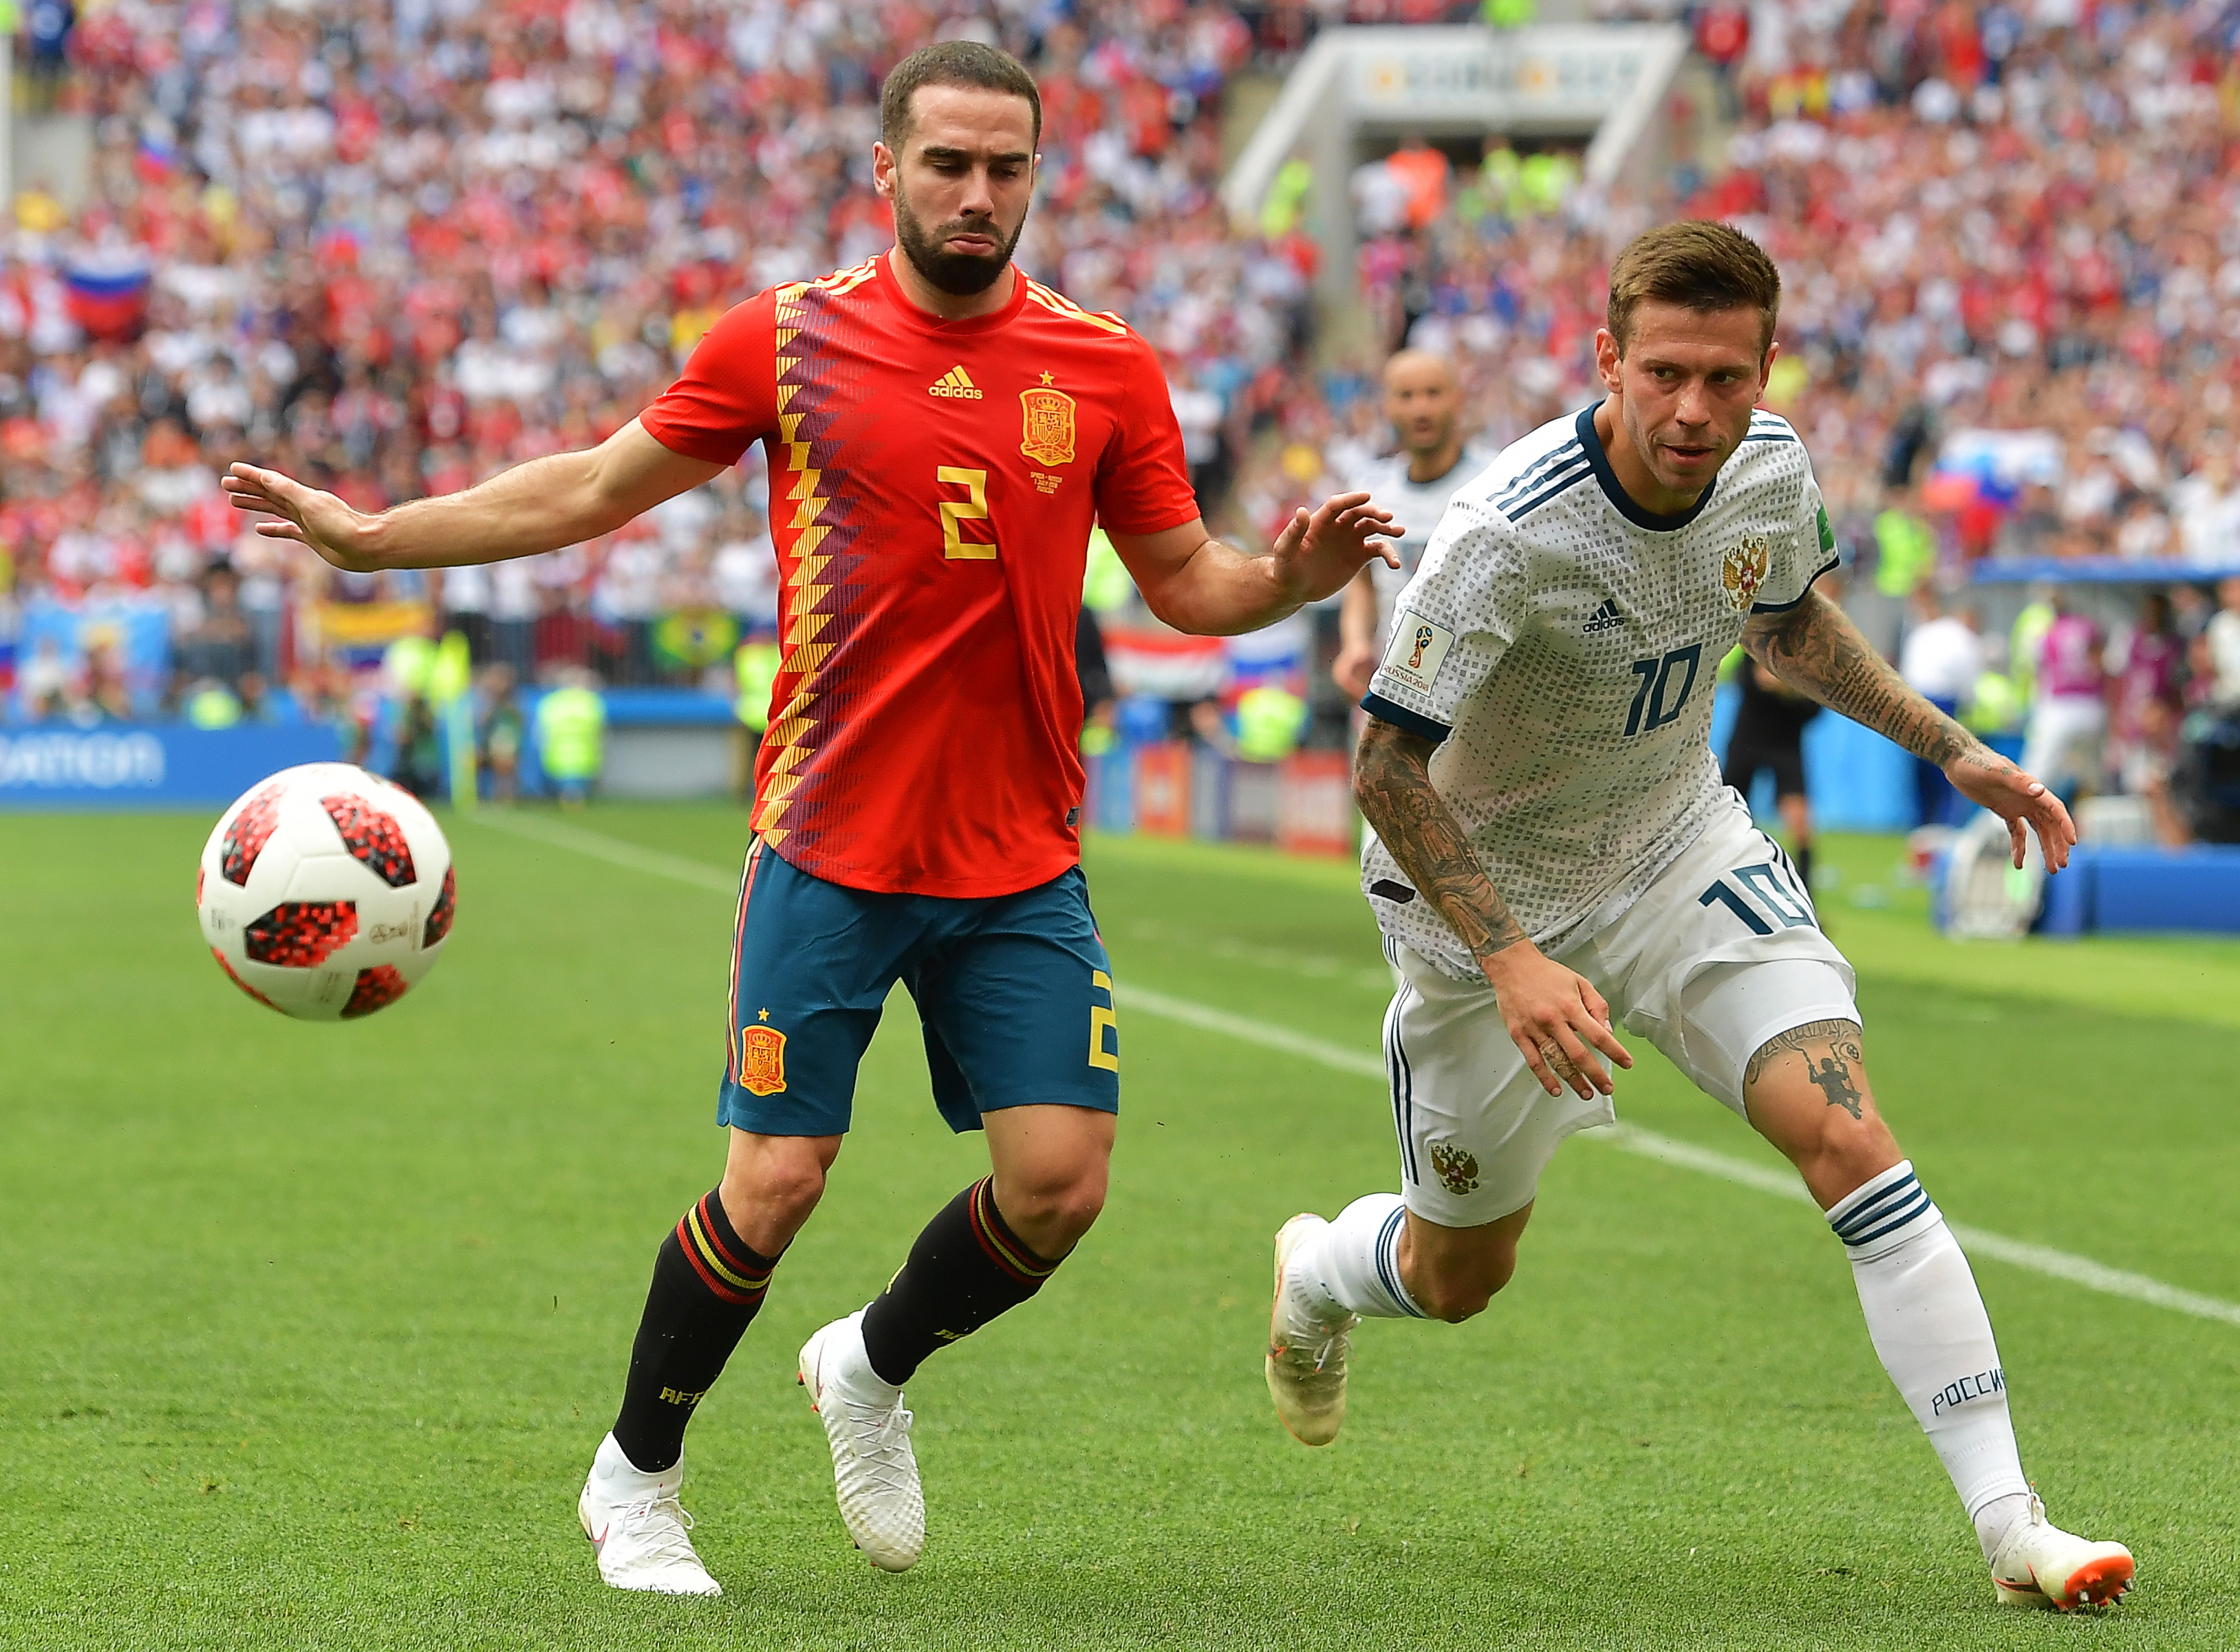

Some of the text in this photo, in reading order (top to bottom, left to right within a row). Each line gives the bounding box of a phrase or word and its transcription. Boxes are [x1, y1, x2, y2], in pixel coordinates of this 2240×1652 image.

[929, 387, 982, 399] adidas
[937, 466, 997, 560] 2
[1582, 617, 1625, 633] adidas
[1383, 665, 1429, 692] RUSSIA 2018
[1624, 642, 1703, 737] 10
[1697, 862, 1816, 935] 10
[1088, 970, 1119, 1073] 2
